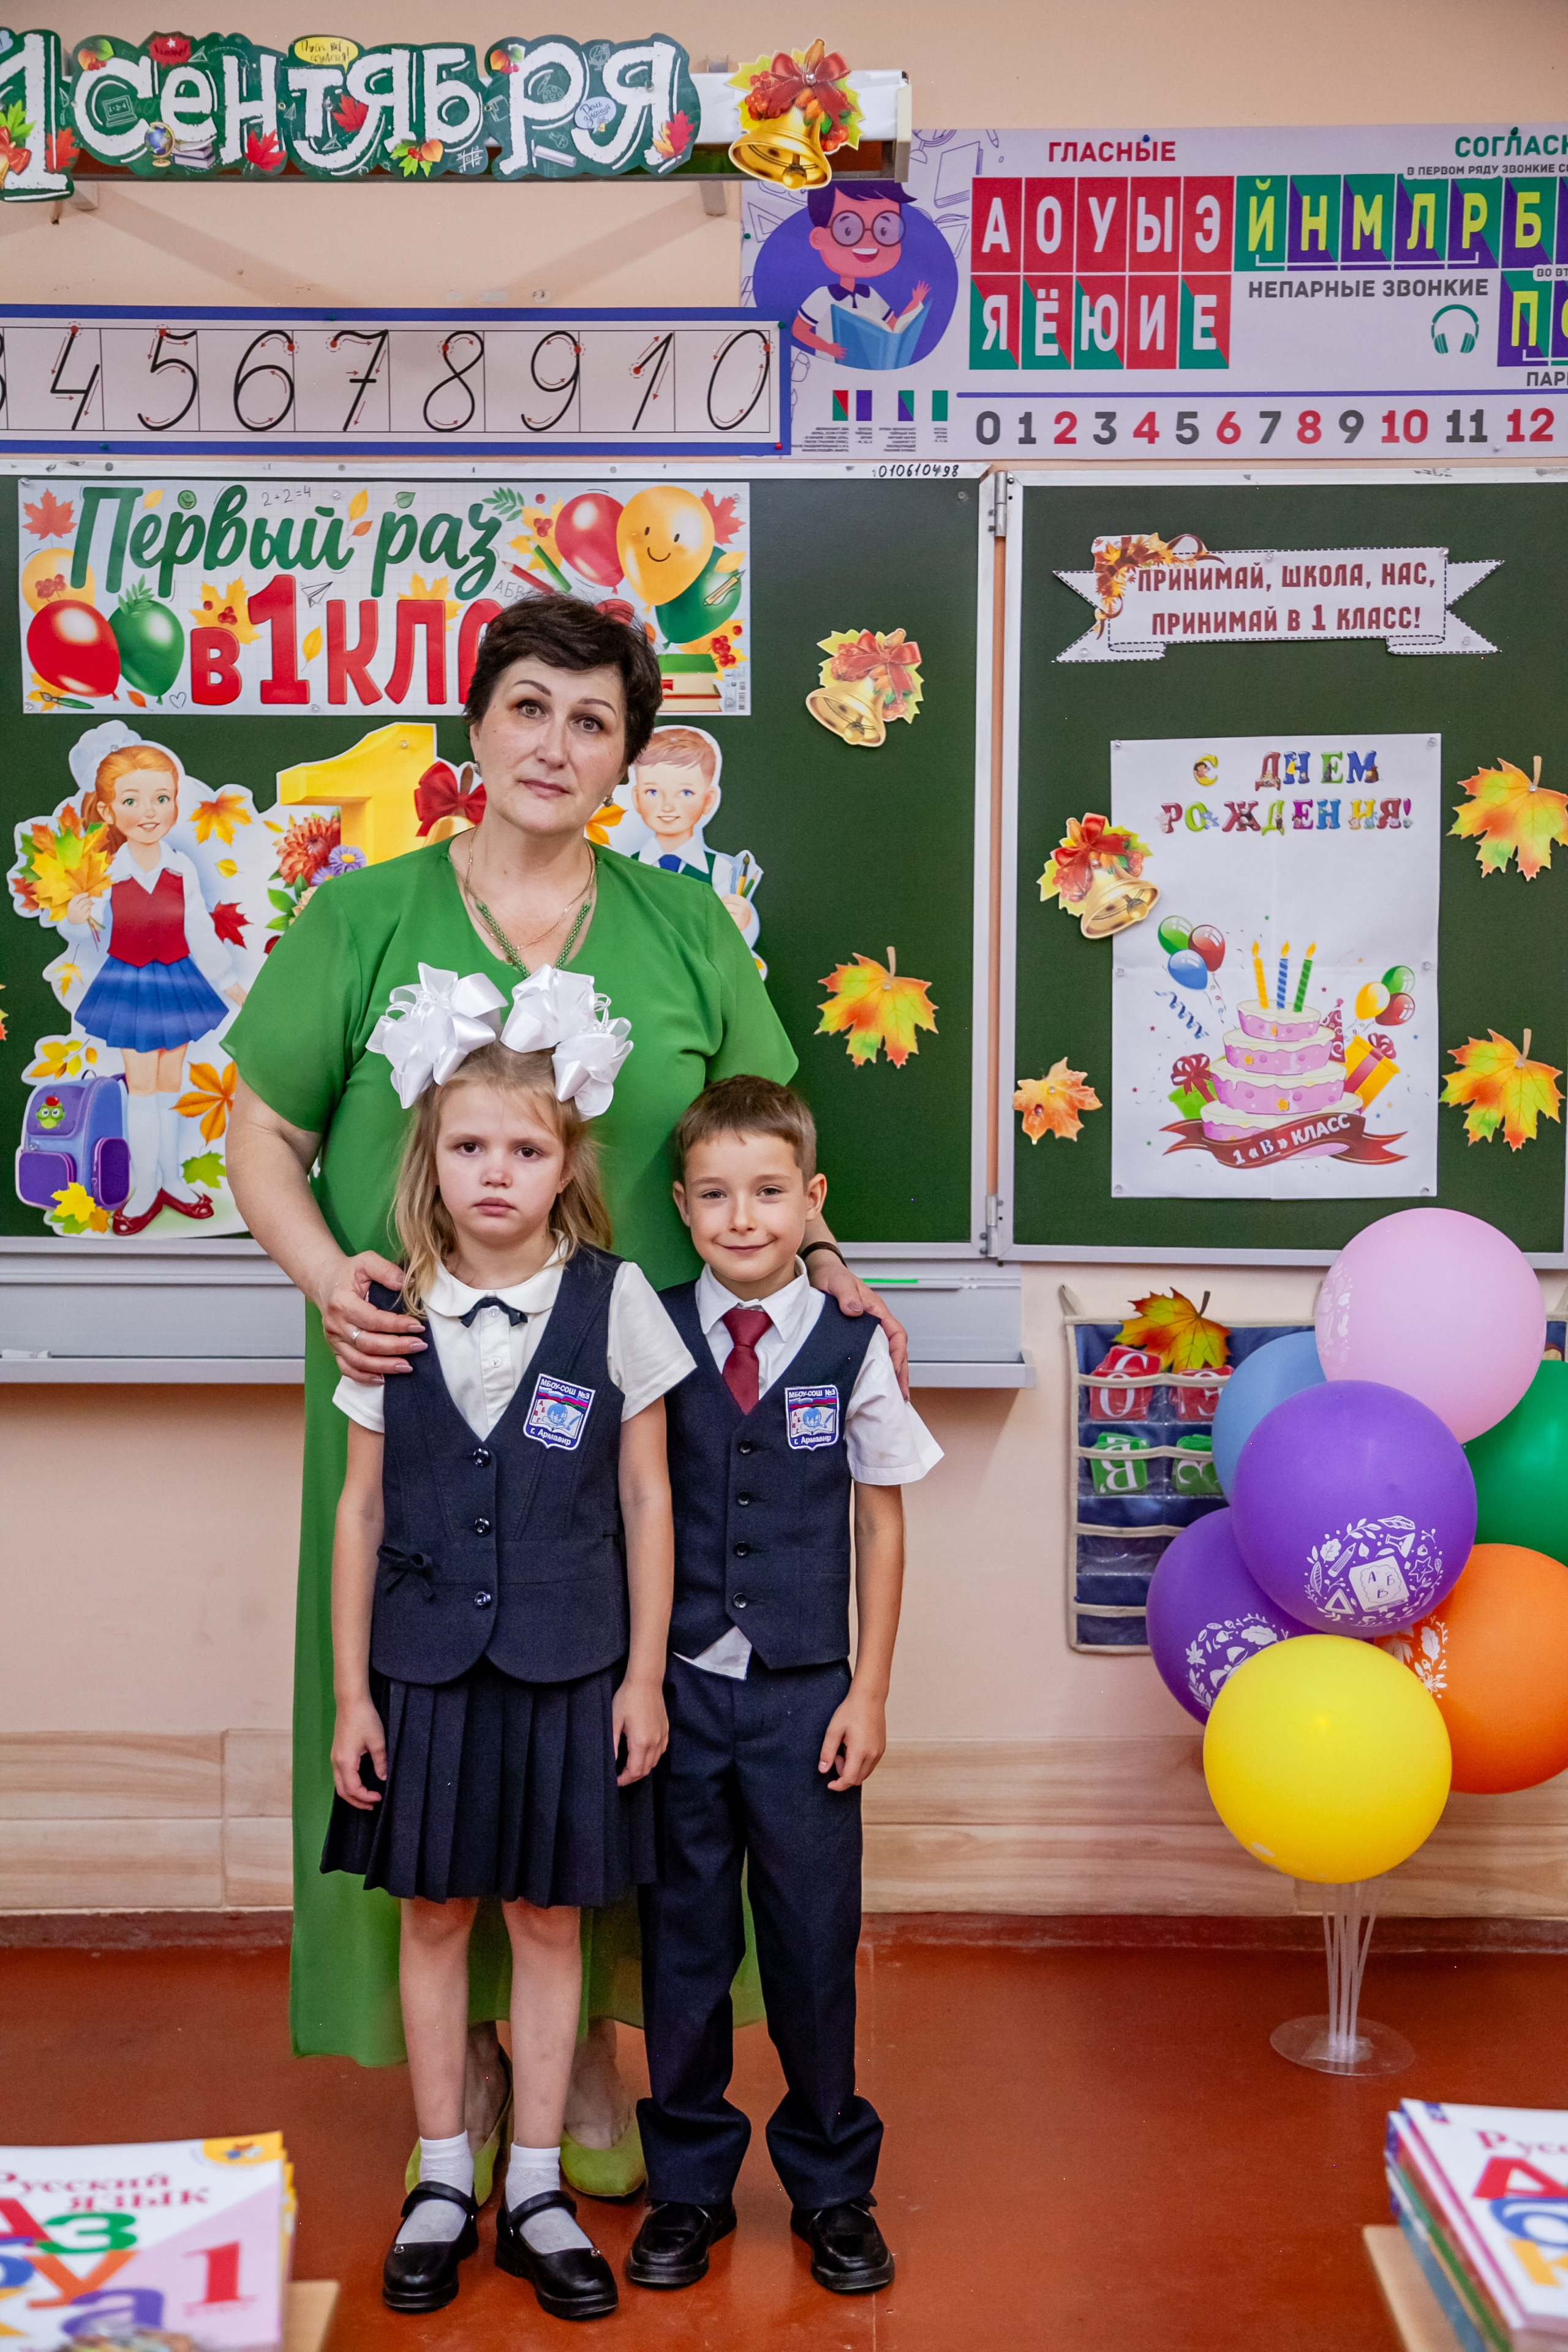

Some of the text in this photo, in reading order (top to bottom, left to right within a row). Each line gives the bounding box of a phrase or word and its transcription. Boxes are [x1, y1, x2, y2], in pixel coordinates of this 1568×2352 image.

[1048, 141, 1177, 162] ГЛАСНЫЕ
[1407, 163, 1568, 175] В ПЕРВОМ РЯДУ ЗВОНКИЕ С
[981, 195, 1221, 254] А О У Ы Э
[1248, 178, 1542, 252] Й Н М Л Р Б
[1248, 278, 1489, 299] НЕПАРНЫЕ ЗВОНКИЕ
[1537, 268, 1552, 277] ВО
[981, 288, 1218, 356] Я Ё Ю И Е
[50, 325, 100, 431] 4
[137, 328, 198, 432] 5
[234, 330, 295, 431] 6
[329, 329, 389, 431] 7
[423, 331, 485, 431] 8
[520, 331, 581, 431] 9
[1526, 371, 1568, 386] ПАР
[976, 410, 1001, 445] 0
[1017, 411, 1037, 444] 1
[1053, 410, 1077, 444] 2
[1092, 411, 1117, 445] 3
[1133, 411, 1159, 444] 4
[1175, 411, 1200, 445] 5
[1216, 411, 1242, 444] 6
[1259, 411, 1281, 444] 7
[1297, 410, 1322, 444] 8
[1338, 410, 1364, 443] 9
[1381, 409, 1428, 443] 10
[1446, 409, 1488, 443] 11
[1507, 408, 1555, 442] 12
[70, 484, 503, 601] Первый раз
[1138, 561, 1436, 592] ПРИНИМАЙ, ШКОЛА, НАС,
[1152, 605, 1421, 635] ПРИНИМАЙ В 1 КЛАСС!
[247, 574, 311, 704] 1
[1193, 750, 1381, 791] С ДНЕМ
[1158, 797, 1413, 836] РОЖДЕНИЯ!
[1233, 1150, 1245, 1165] 1
[1290, 1114, 1351, 1146] КЛАСС
[540, 1378, 590, 1399] МБОУ-СОШ №3
[789, 1390, 823, 1398] МБОУ-СОШ
[537, 1428, 571, 1446] Армавир
[801, 1436, 832, 1445] Армавир
[186, 2240, 257, 2305] 1
